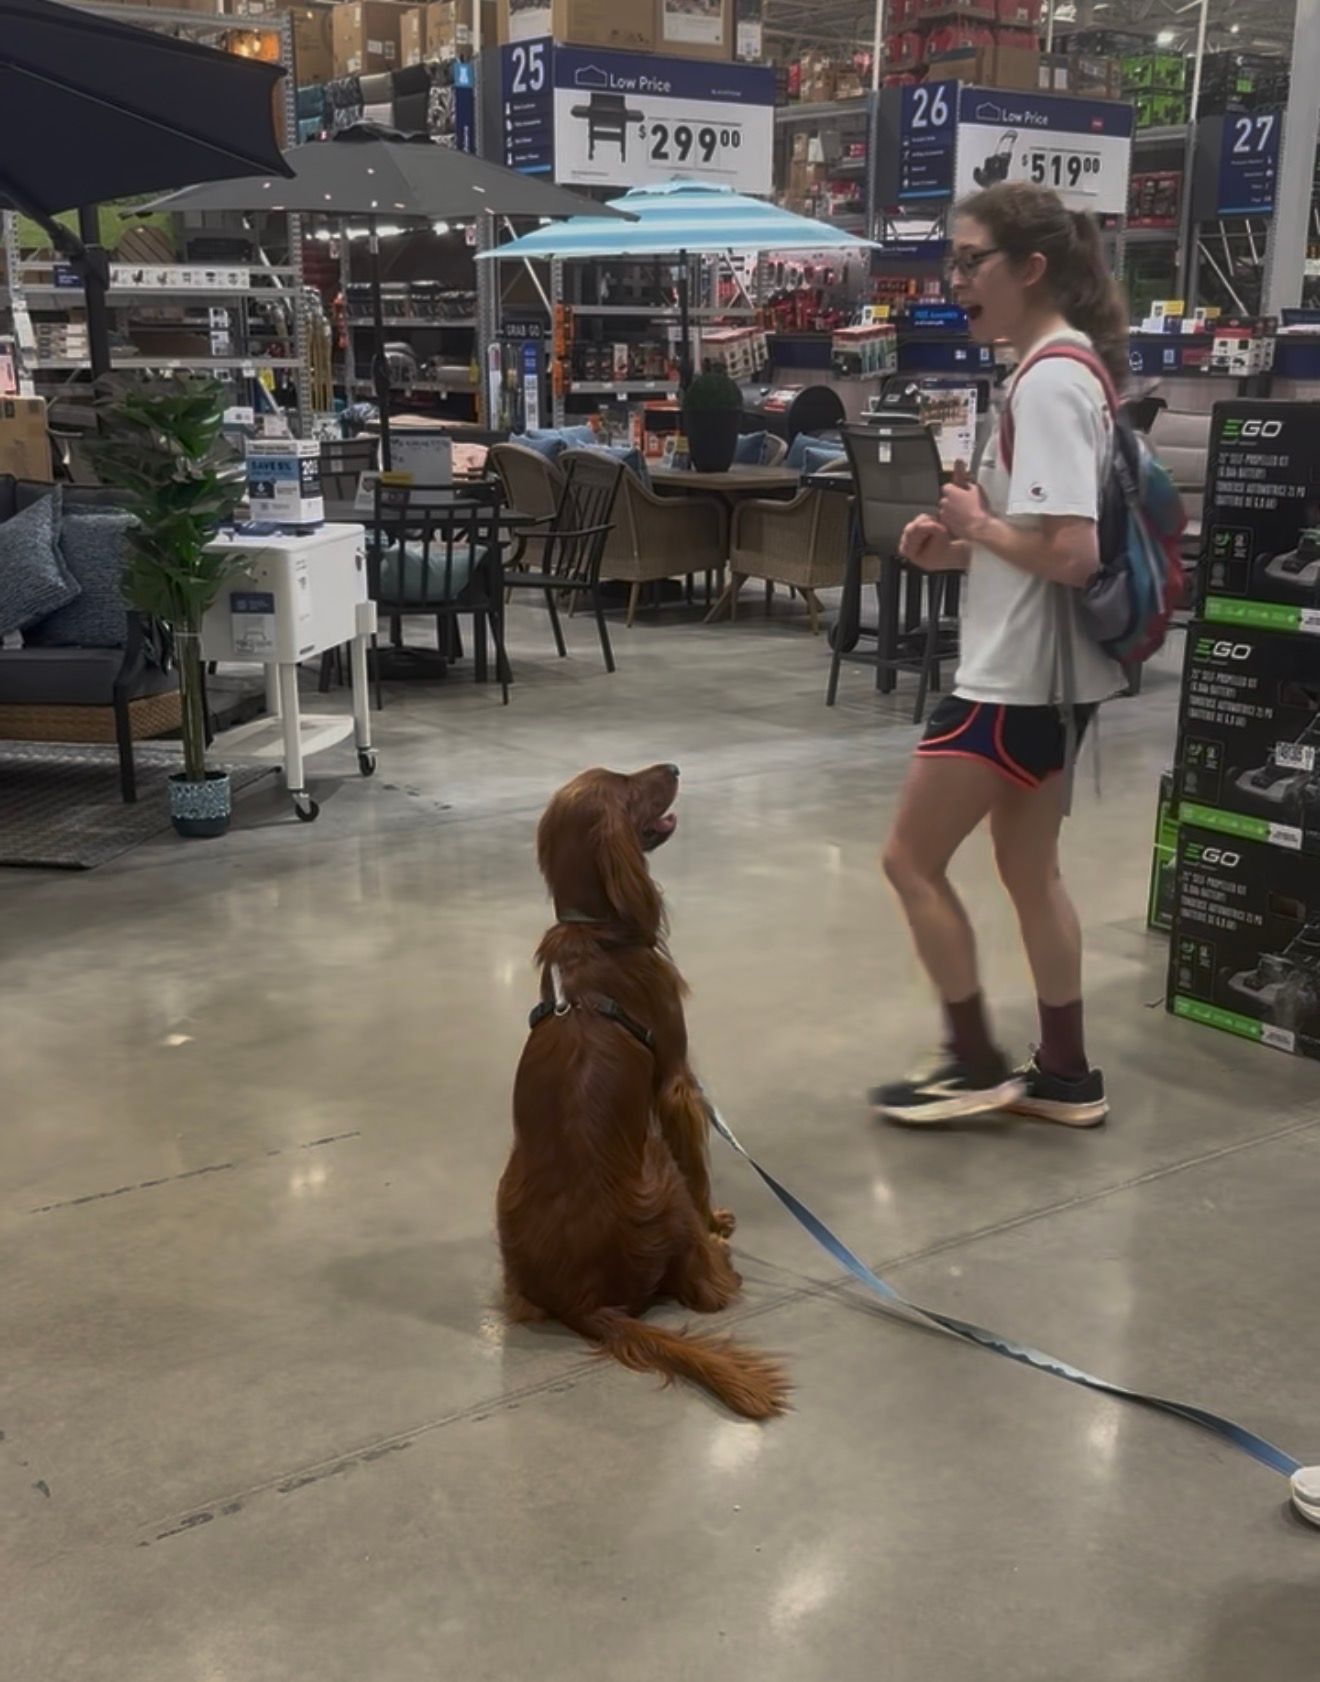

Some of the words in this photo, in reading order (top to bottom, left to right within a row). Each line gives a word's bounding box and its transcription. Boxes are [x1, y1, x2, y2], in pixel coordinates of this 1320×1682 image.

[512, 43, 545, 93] 25
[609, 73, 636, 90] Low
[639, 76, 672, 93] Price
[911, 85, 948, 128] 26
[1002, 108, 1024, 122] Low
[1025, 110, 1049, 126] Price
[1232, 115, 1274, 153] 27
[1221, 418, 1283, 438] EGO
[1194, 637, 1252, 660] EGO
[1182, 842, 1241, 868] EGO
